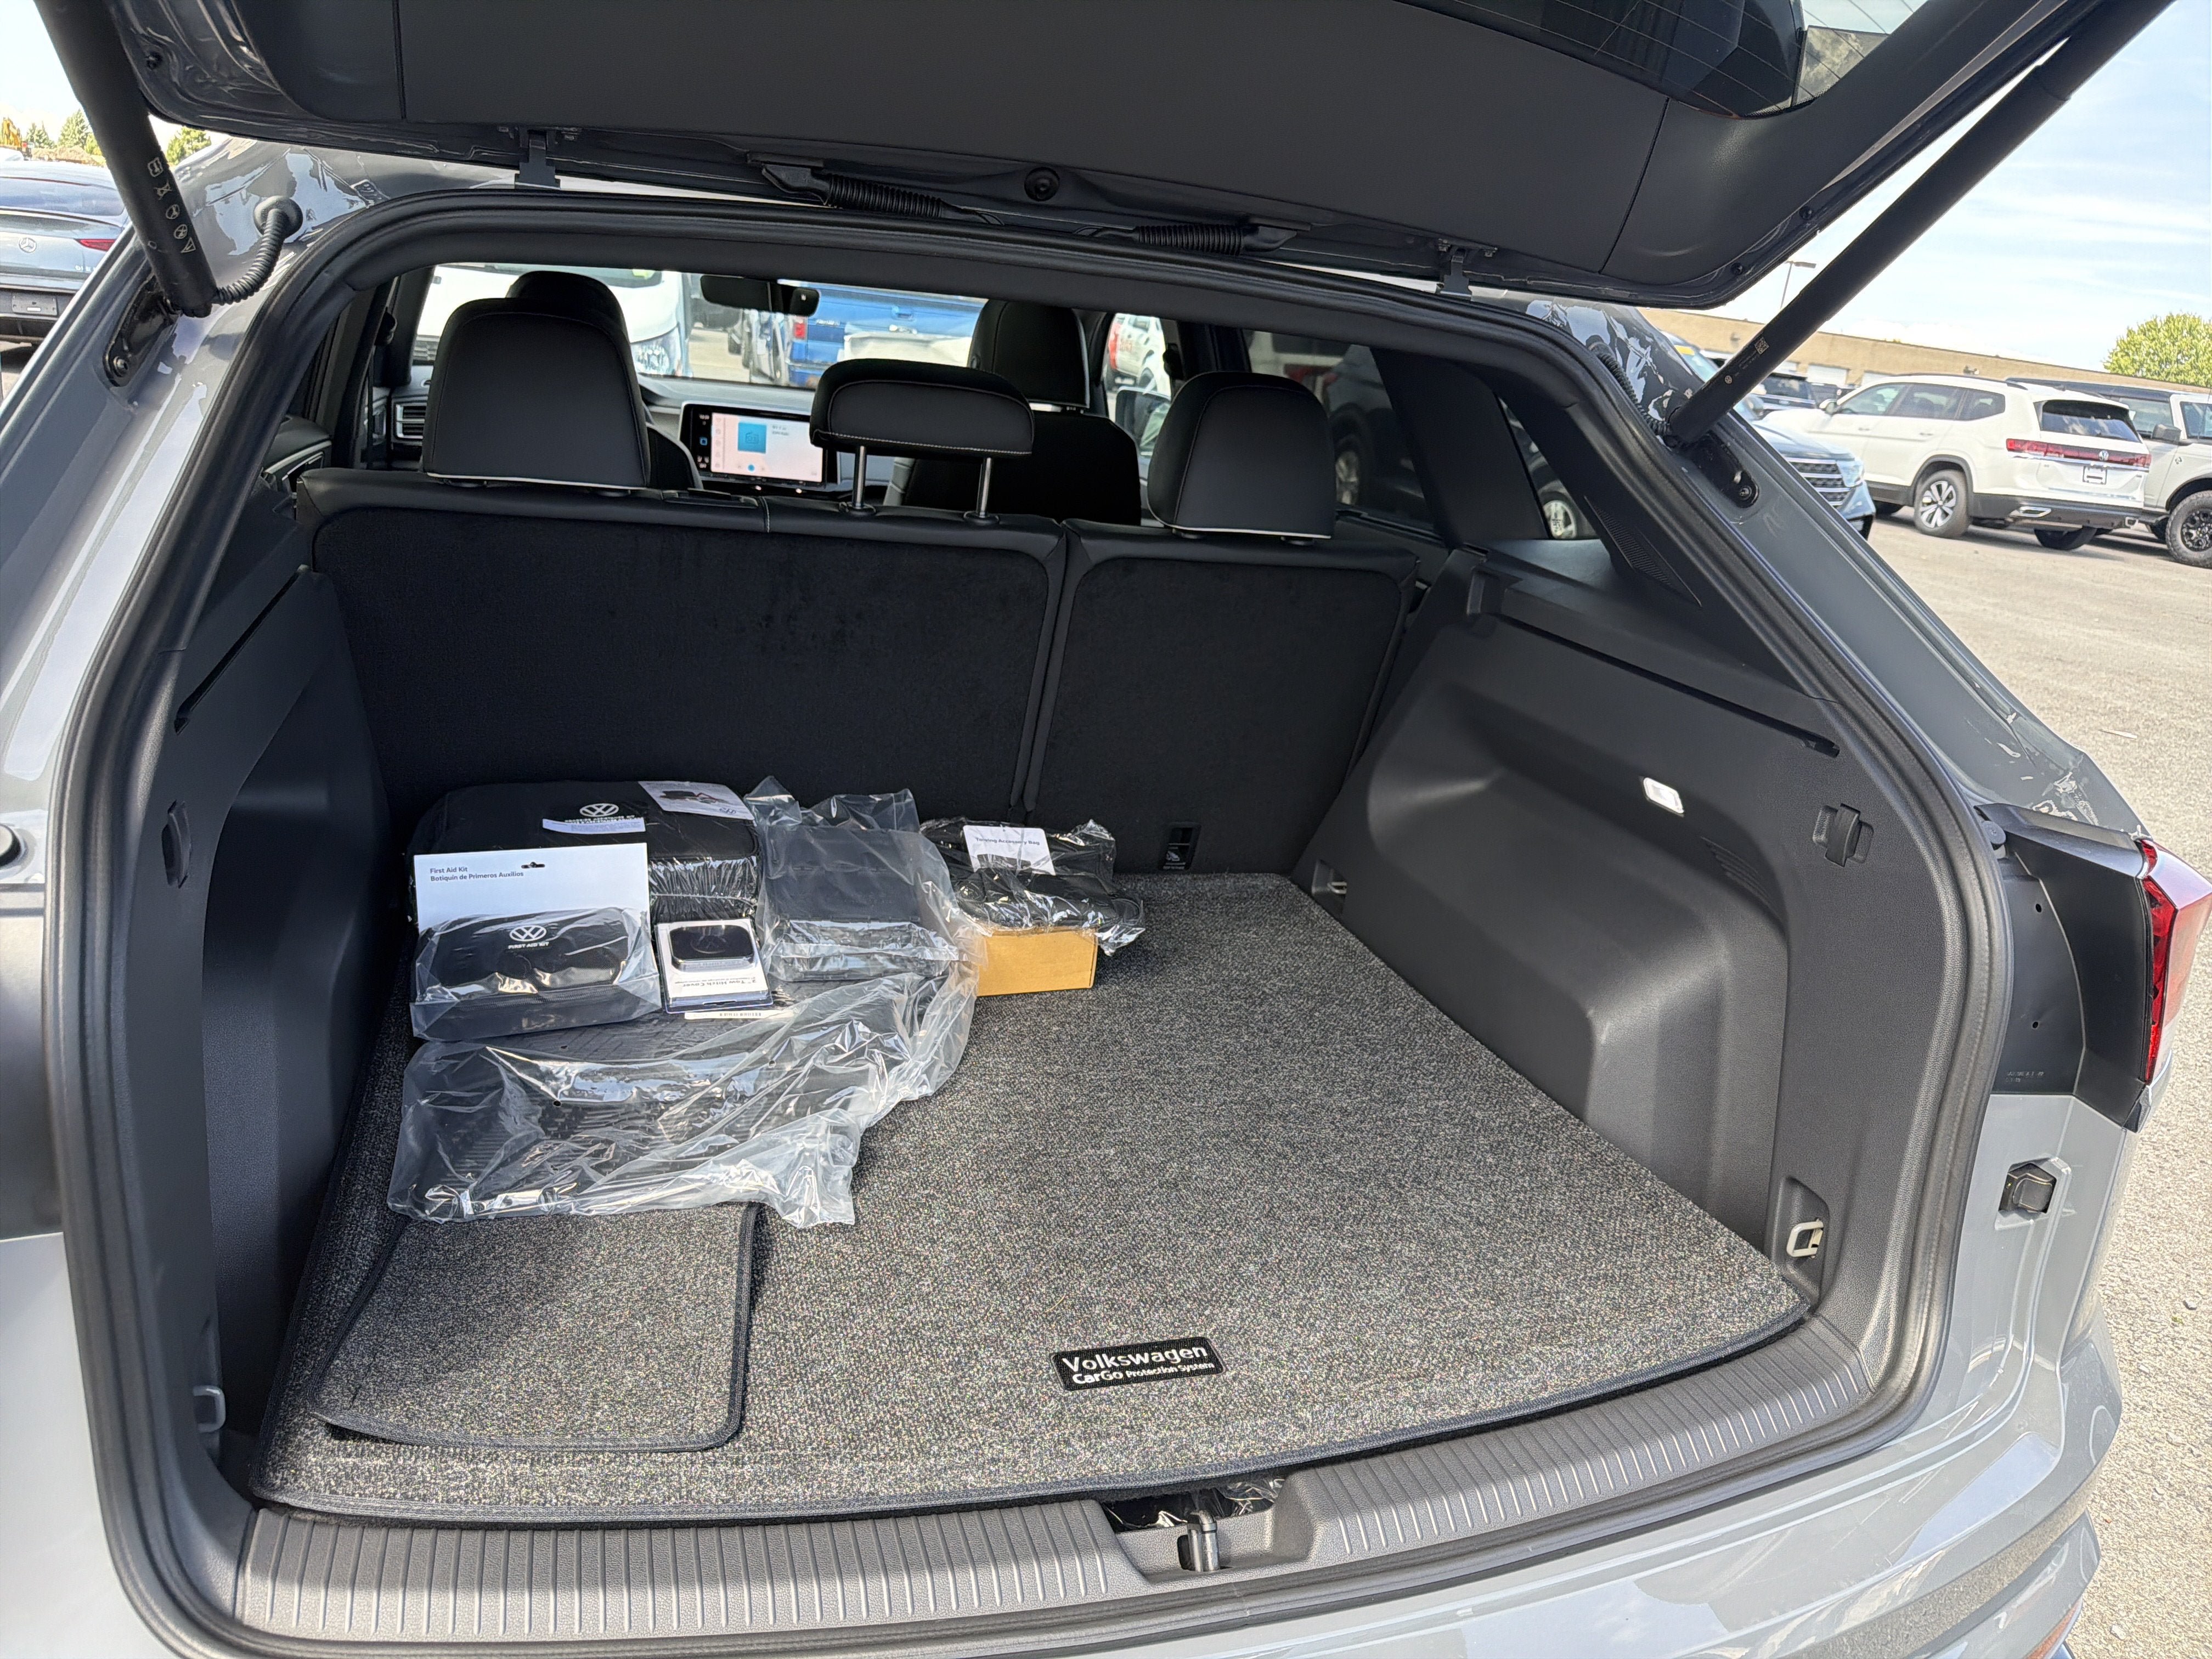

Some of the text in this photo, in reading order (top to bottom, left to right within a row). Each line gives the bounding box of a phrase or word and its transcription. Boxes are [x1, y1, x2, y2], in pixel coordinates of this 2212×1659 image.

[1062, 1346, 1209, 1373] Volkswagen
[1072, 1362, 1215, 1384] CarGo Protection System
